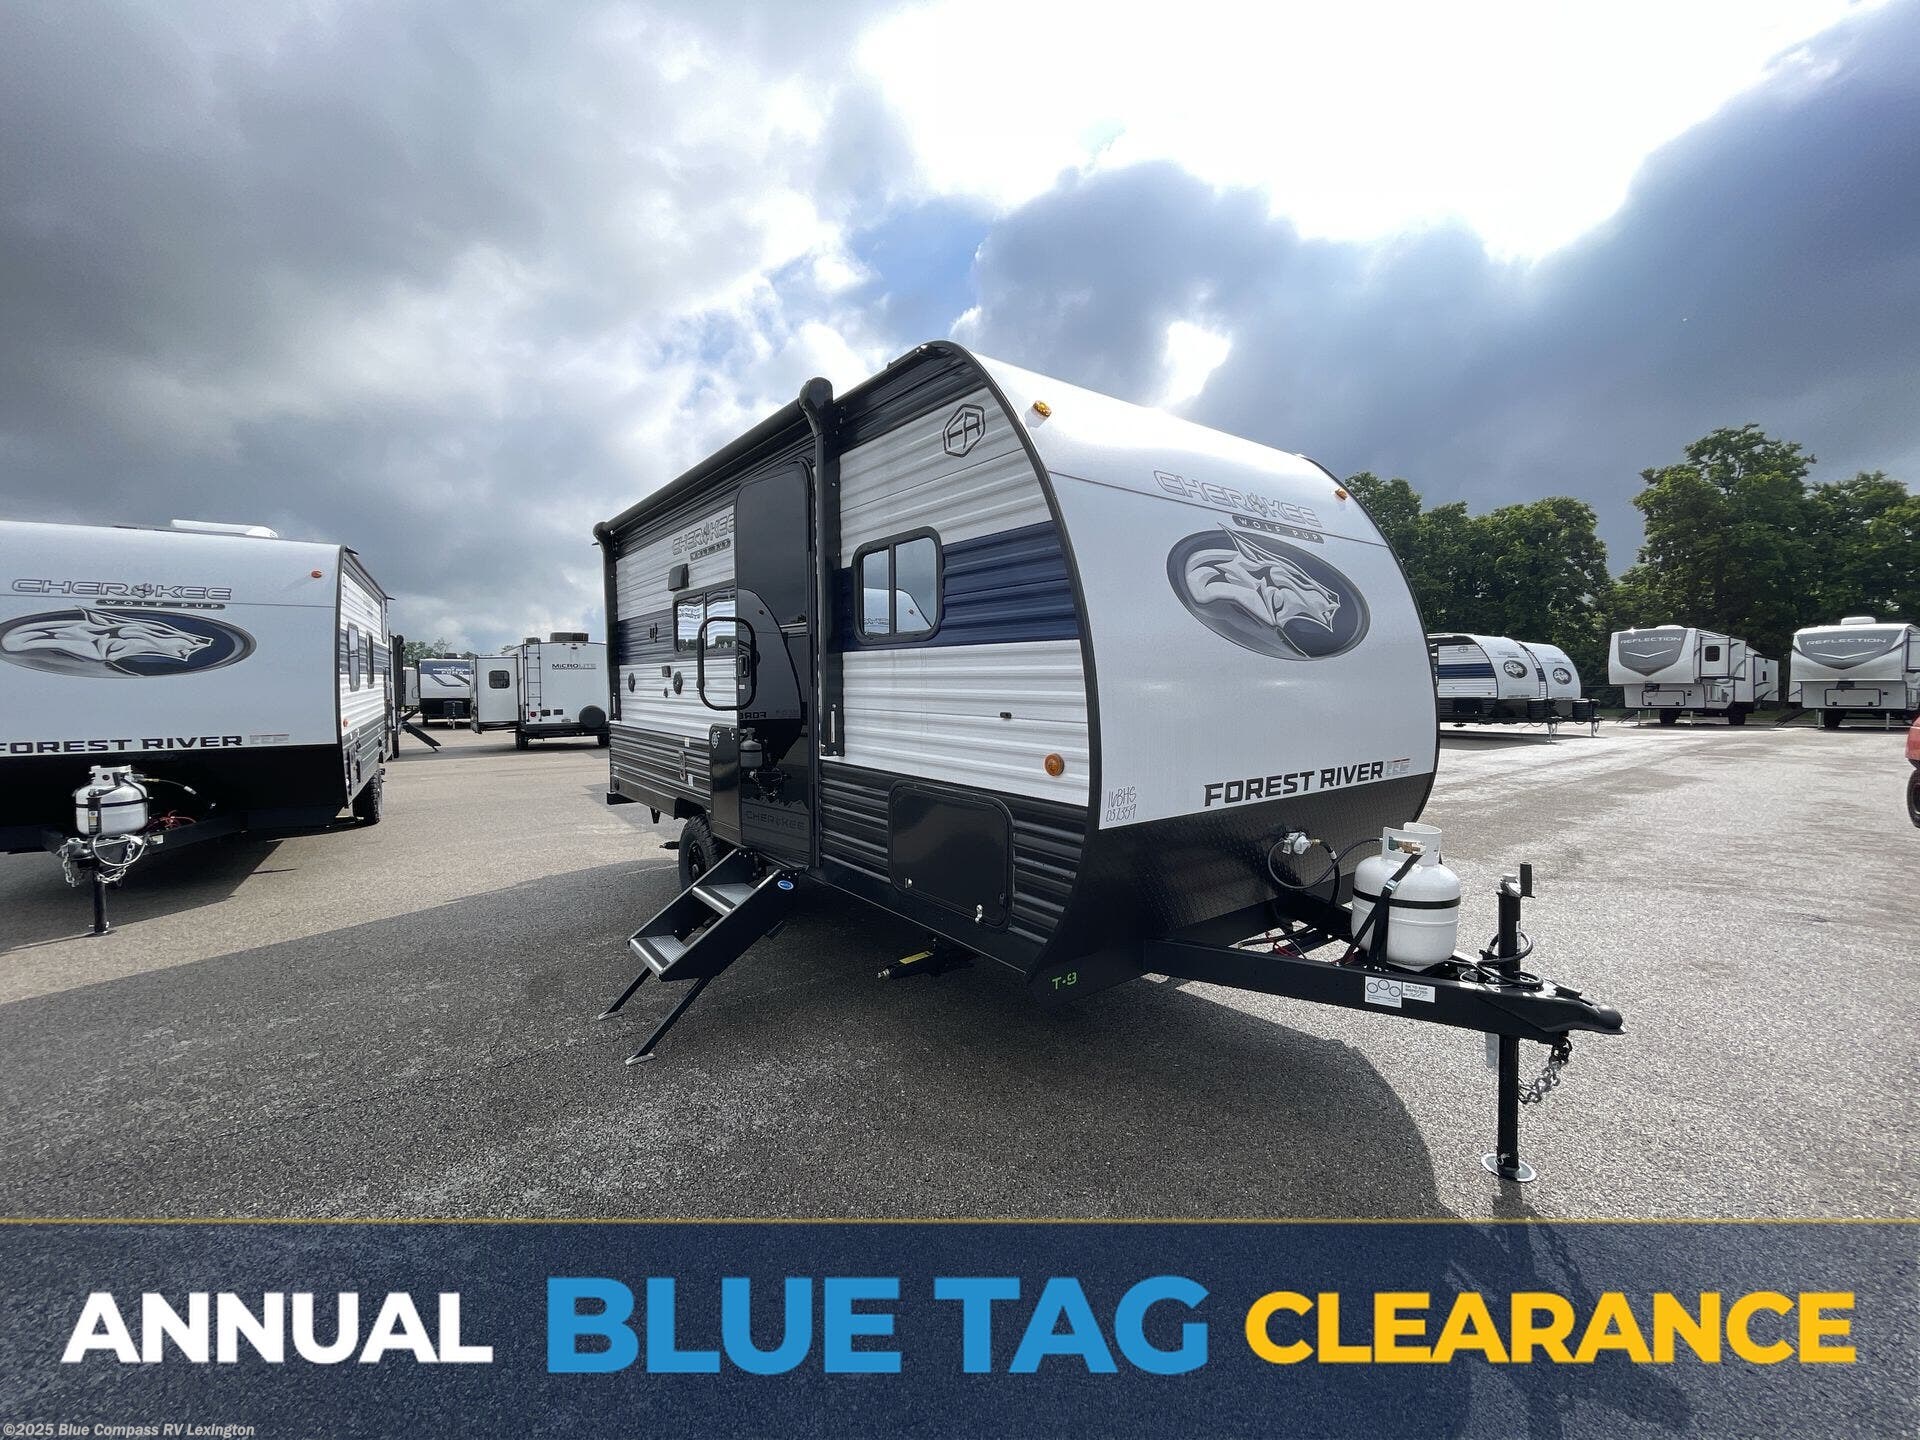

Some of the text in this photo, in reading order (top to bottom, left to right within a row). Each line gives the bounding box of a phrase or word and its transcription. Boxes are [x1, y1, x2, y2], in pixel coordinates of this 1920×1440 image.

[1238, 518, 1320, 540] WOLF PUP
[1620, 636, 1682, 645] REFLECTION
[1806, 638, 1888, 646] REFLECTION
[0, 739, 133, 754] OREST
[141, 735, 243, 750] RIVER
[1204, 770, 1315, 807] FOREST
[1319, 761, 1384, 789] RIVER
